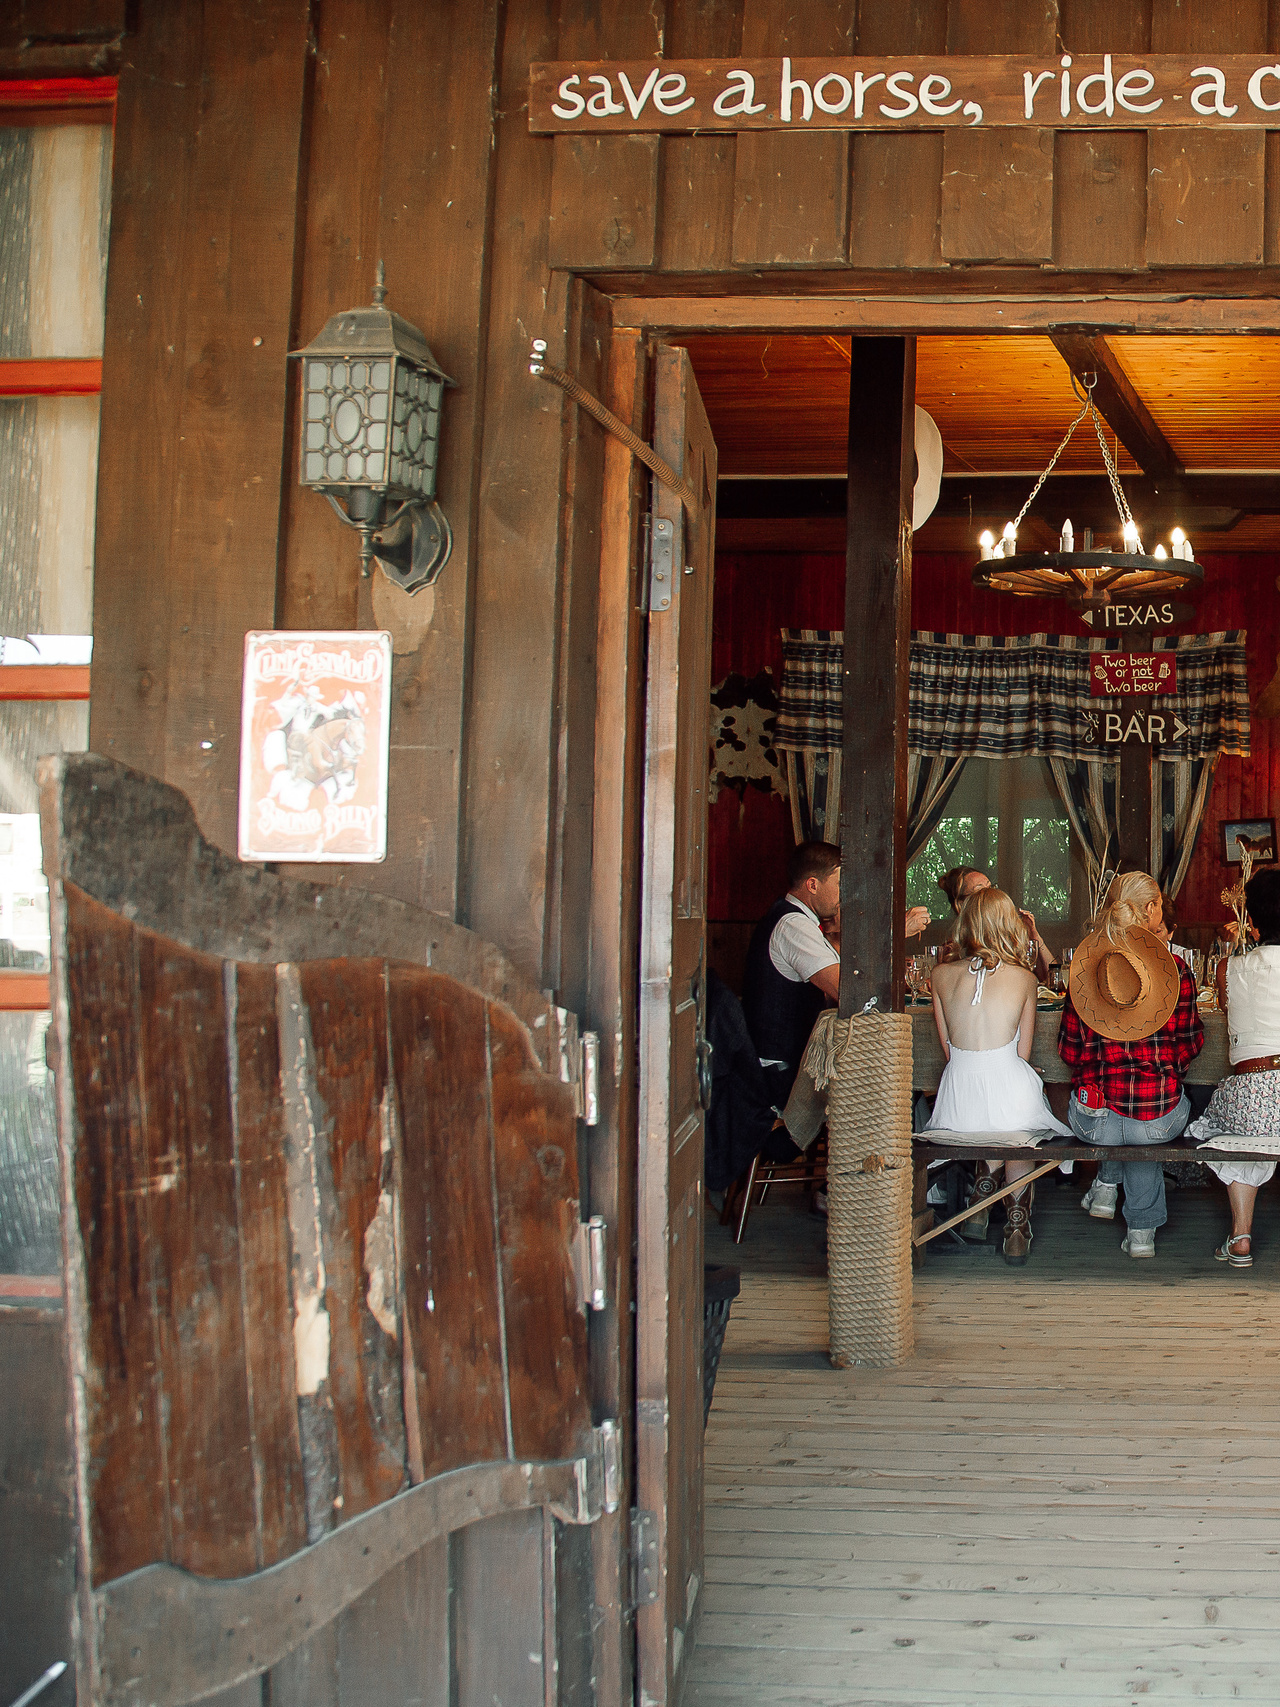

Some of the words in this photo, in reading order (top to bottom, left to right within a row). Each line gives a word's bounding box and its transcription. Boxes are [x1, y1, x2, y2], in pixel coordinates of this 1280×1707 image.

[551, 68, 695, 120] save
[712, 70, 767, 118] a
[779, 56, 984, 126] horse,
[1022, 54, 1164, 119] ride
[1190, 65, 1239, 118] a
[1098, 603, 1174, 627] TEXAS
[1101, 655, 1127, 668] Two
[1129, 653, 1157, 666] beer
[1115, 668, 1129, 678] or
[1132, 665, 1154, 677] not
[1103, 678, 1131, 693] two
[1134, 678, 1163, 692] beer
[1105, 713, 1167, 744] BAR
